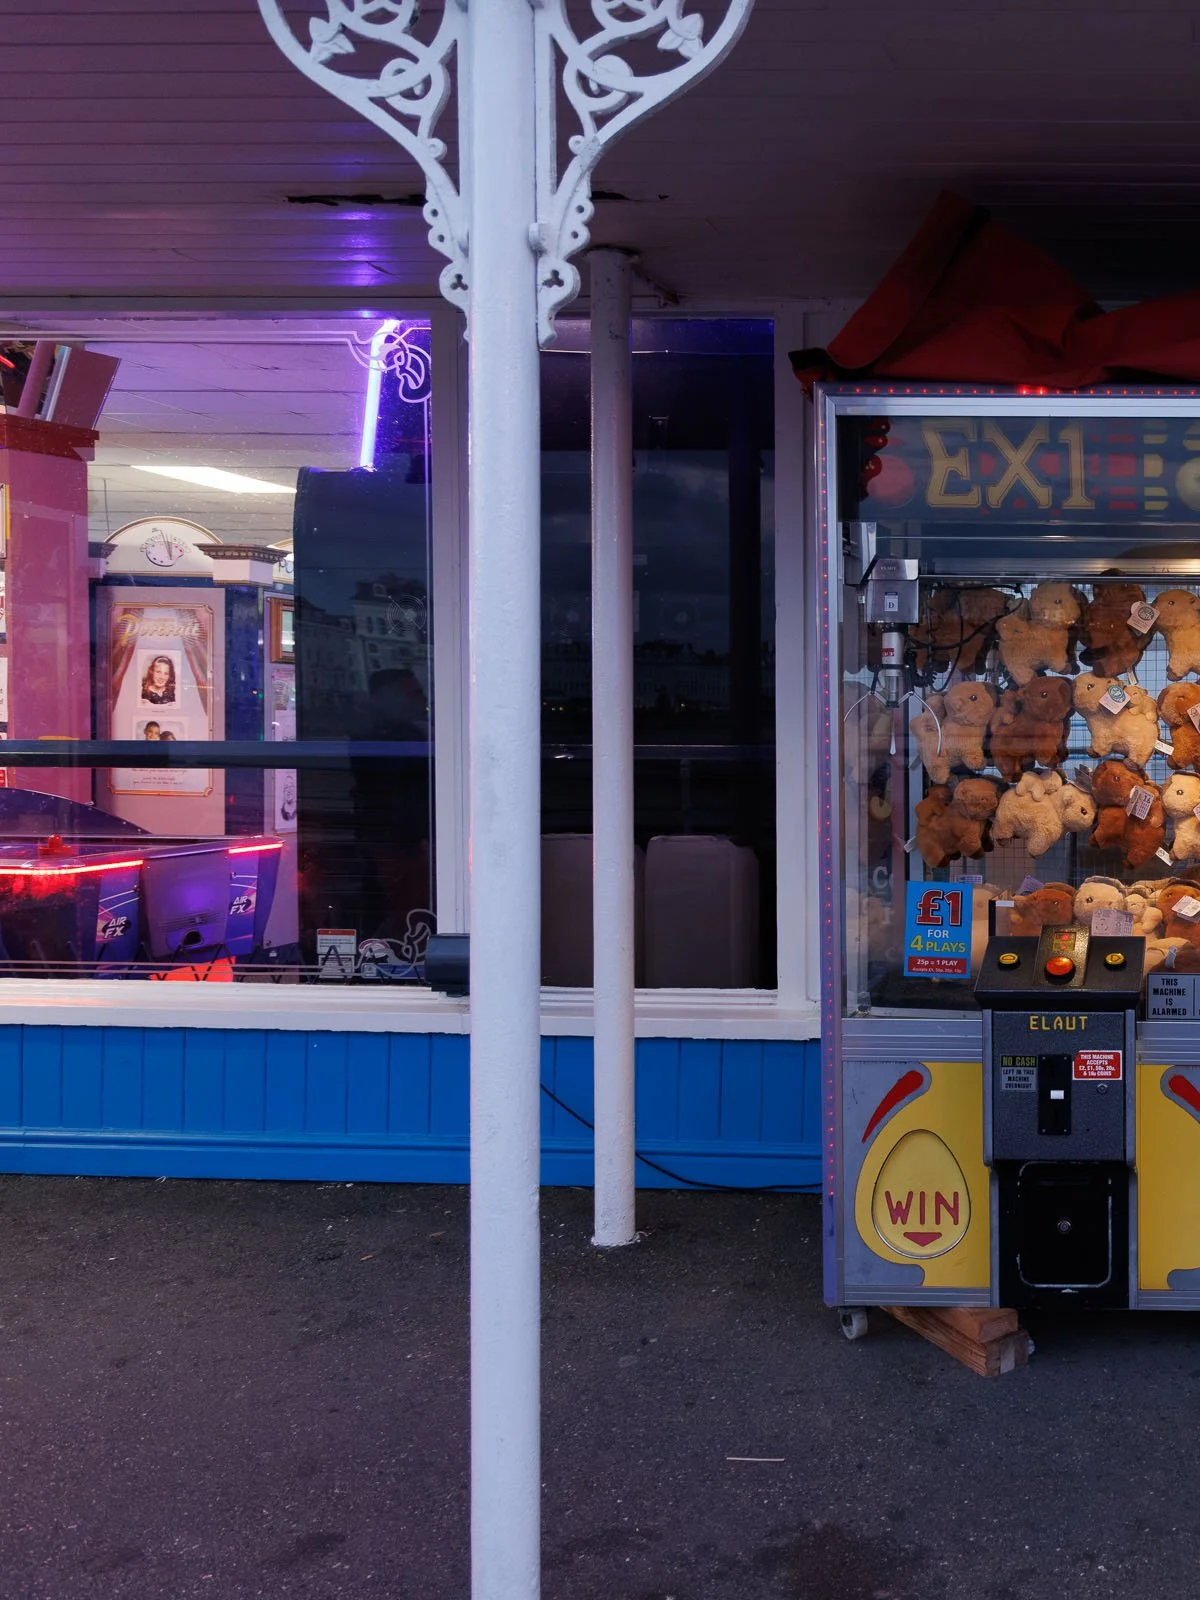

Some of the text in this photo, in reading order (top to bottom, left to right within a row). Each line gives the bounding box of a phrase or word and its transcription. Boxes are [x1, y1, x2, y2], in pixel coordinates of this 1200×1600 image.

[922, 418, 1096, 510] EX1
[233, 895, 248, 905] AIR
[230, 904, 246, 915] FX
[916, 889, 963, 926] £1
[108, 916, 127, 927] AIR
[104, 926, 125, 939] FX
[927, 929, 949, 939] FOR
[910, 934, 966, 953] 4 PLAYS
[1161, 978, 1178, 986] THIS
[1153, 988, 1186, 996] MACHINE
[1165, 998, 1173, 1006] IS
[1152, 1008, 1187, 1016] ALARMED
[1029, 1015, 1088, 1031] ELAUT
[1002, 1056, 1036, 1066] NO CASH
[885, 1190, 959, 1225] WIN
